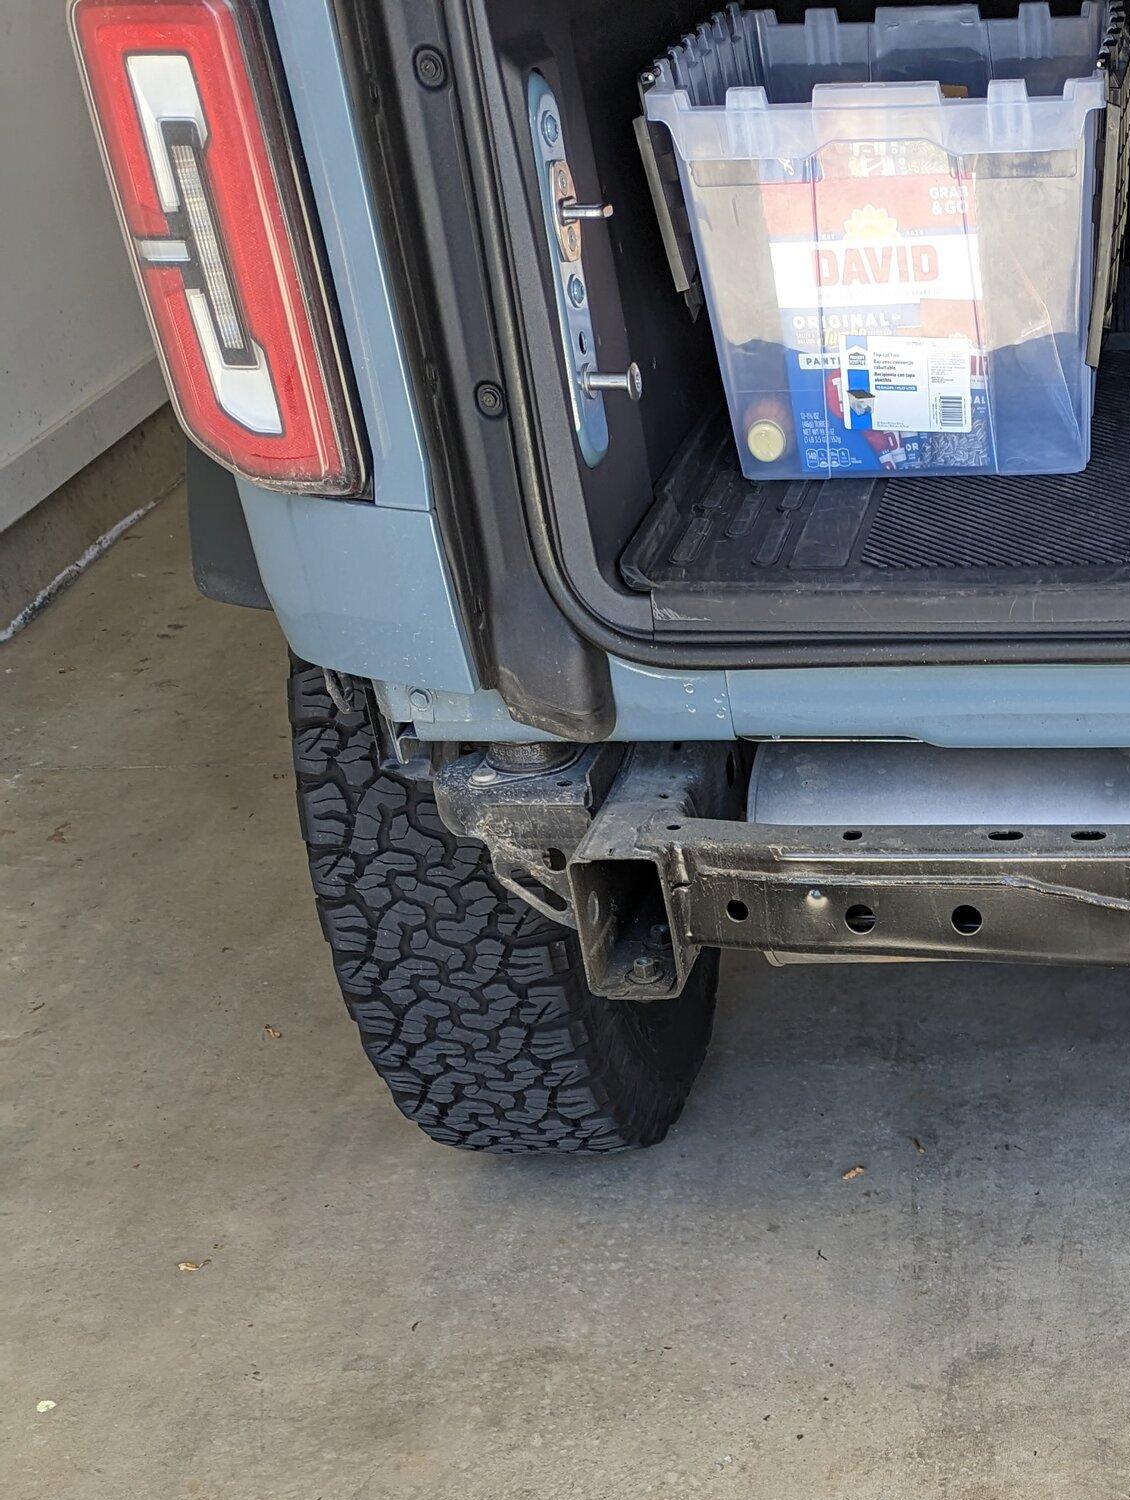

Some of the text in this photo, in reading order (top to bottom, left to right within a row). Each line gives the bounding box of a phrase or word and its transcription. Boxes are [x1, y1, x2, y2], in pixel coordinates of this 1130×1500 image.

[929, 185, 968, 200] GRAB
[811, 244, 940, 287] DAVID
[792, 312, 890, 330] ORIGINAL
